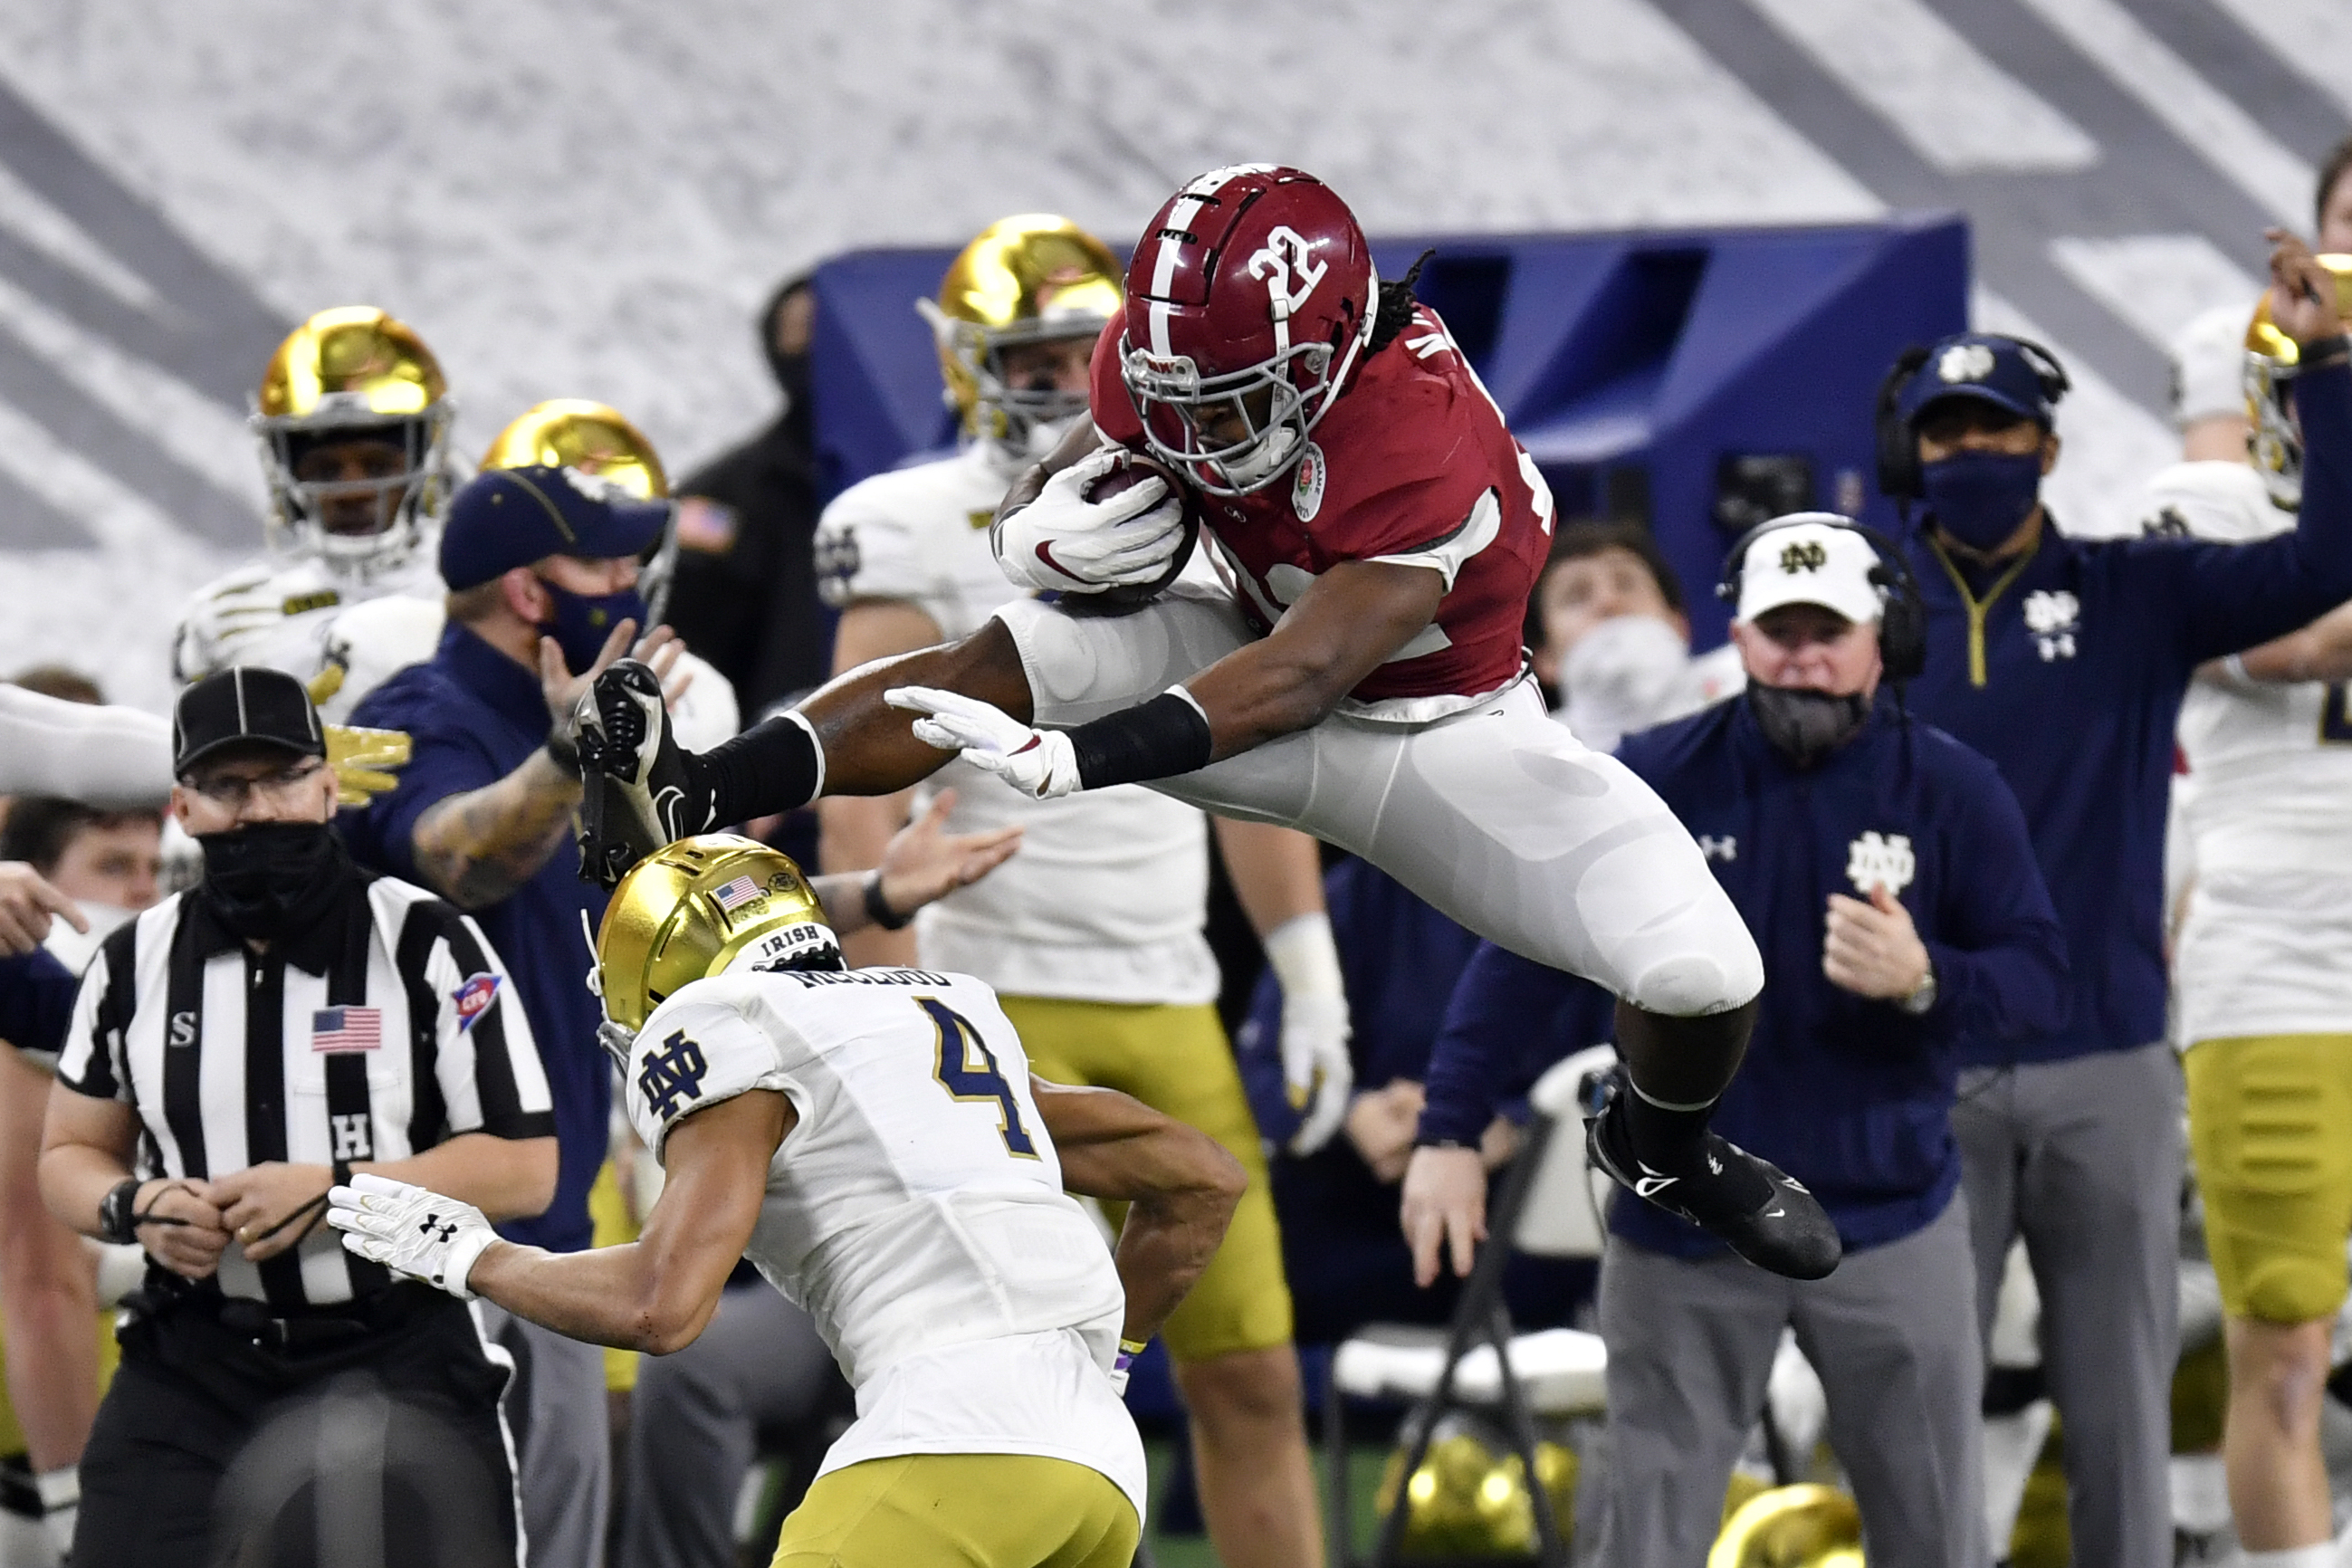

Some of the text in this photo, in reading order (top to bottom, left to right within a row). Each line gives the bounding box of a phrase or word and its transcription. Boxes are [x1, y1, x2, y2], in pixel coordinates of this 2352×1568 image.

[1248, 225, 1329, 313] 22
[760, 923, 820, 958] IRISH
[169, 1010, 197, 1048] S
[637, 1027, 709, 1122] ND
[911, 995, 1044, 1161] 4
[332, 1113, 372, 1161] H
